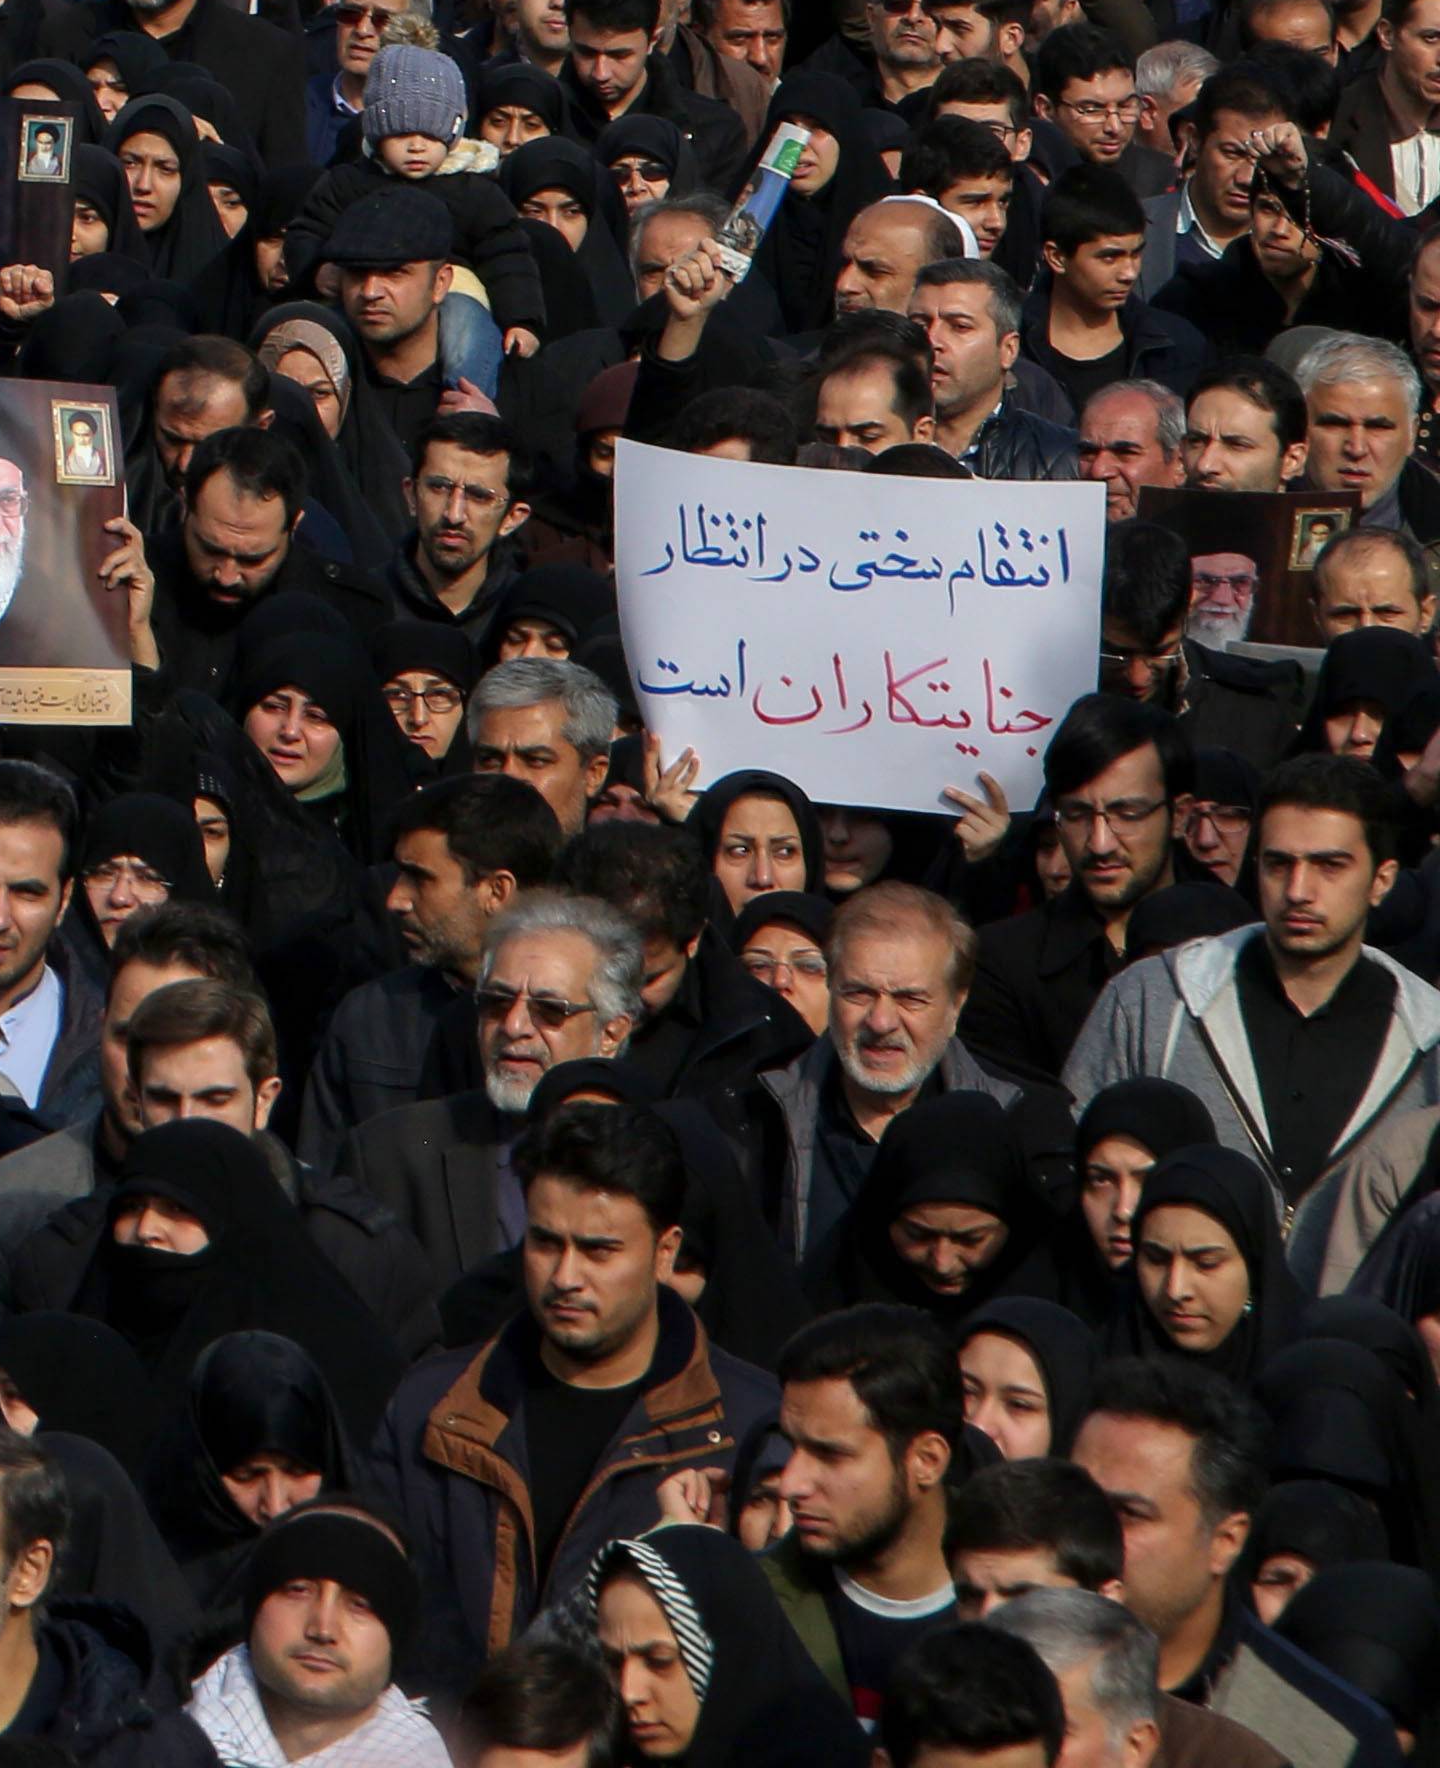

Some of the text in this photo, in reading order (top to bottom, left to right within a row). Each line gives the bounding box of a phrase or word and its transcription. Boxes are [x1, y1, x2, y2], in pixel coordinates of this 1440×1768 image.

[639, 503, 1071, 616] انتقام سختی در انتظار
[638, 638, 746, 697] است
